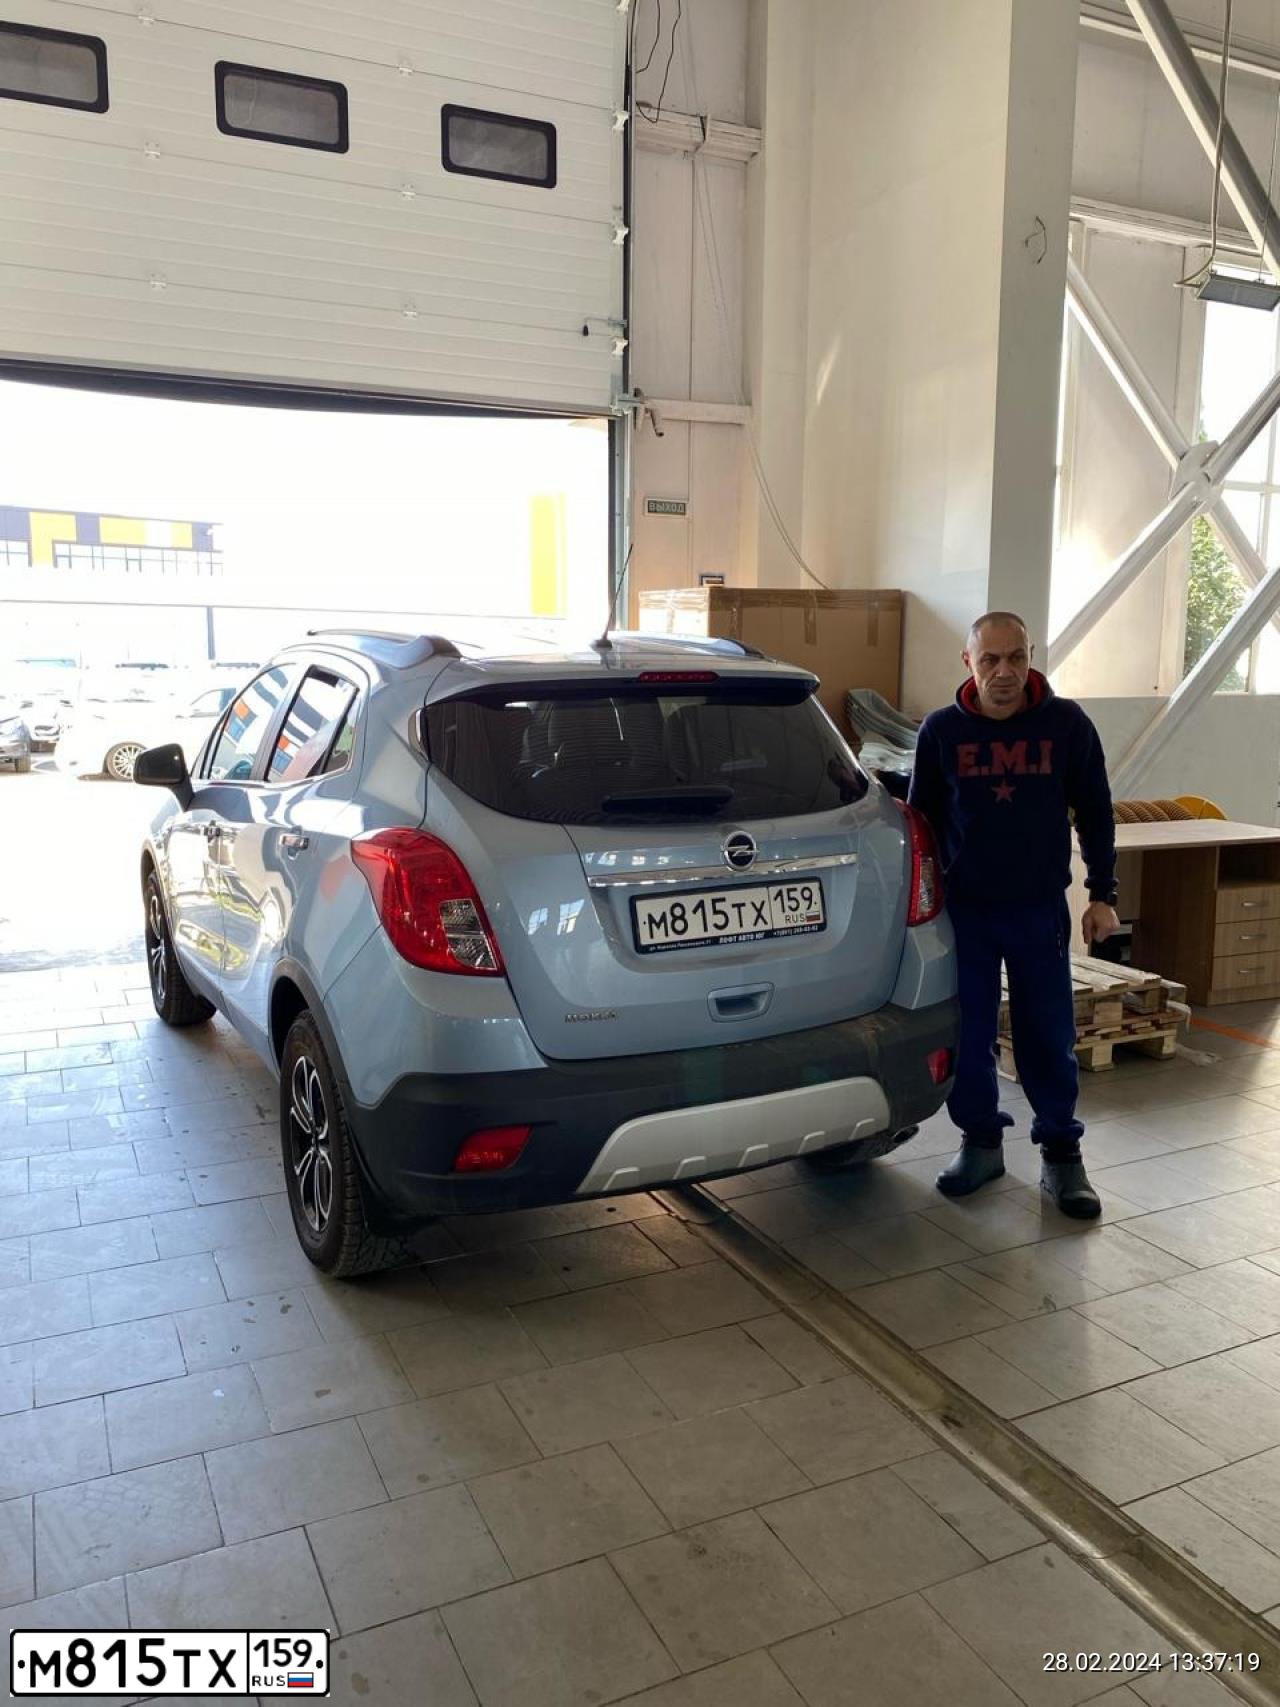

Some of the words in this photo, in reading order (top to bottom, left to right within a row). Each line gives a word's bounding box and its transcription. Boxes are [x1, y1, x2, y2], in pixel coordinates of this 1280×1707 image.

[957, 740, 1053, 777] E.M.I
[774, 886, 813, 913] 159
[647, 897, 769, 939] М815ТХ
[785, 913, 805, 924] RUS
